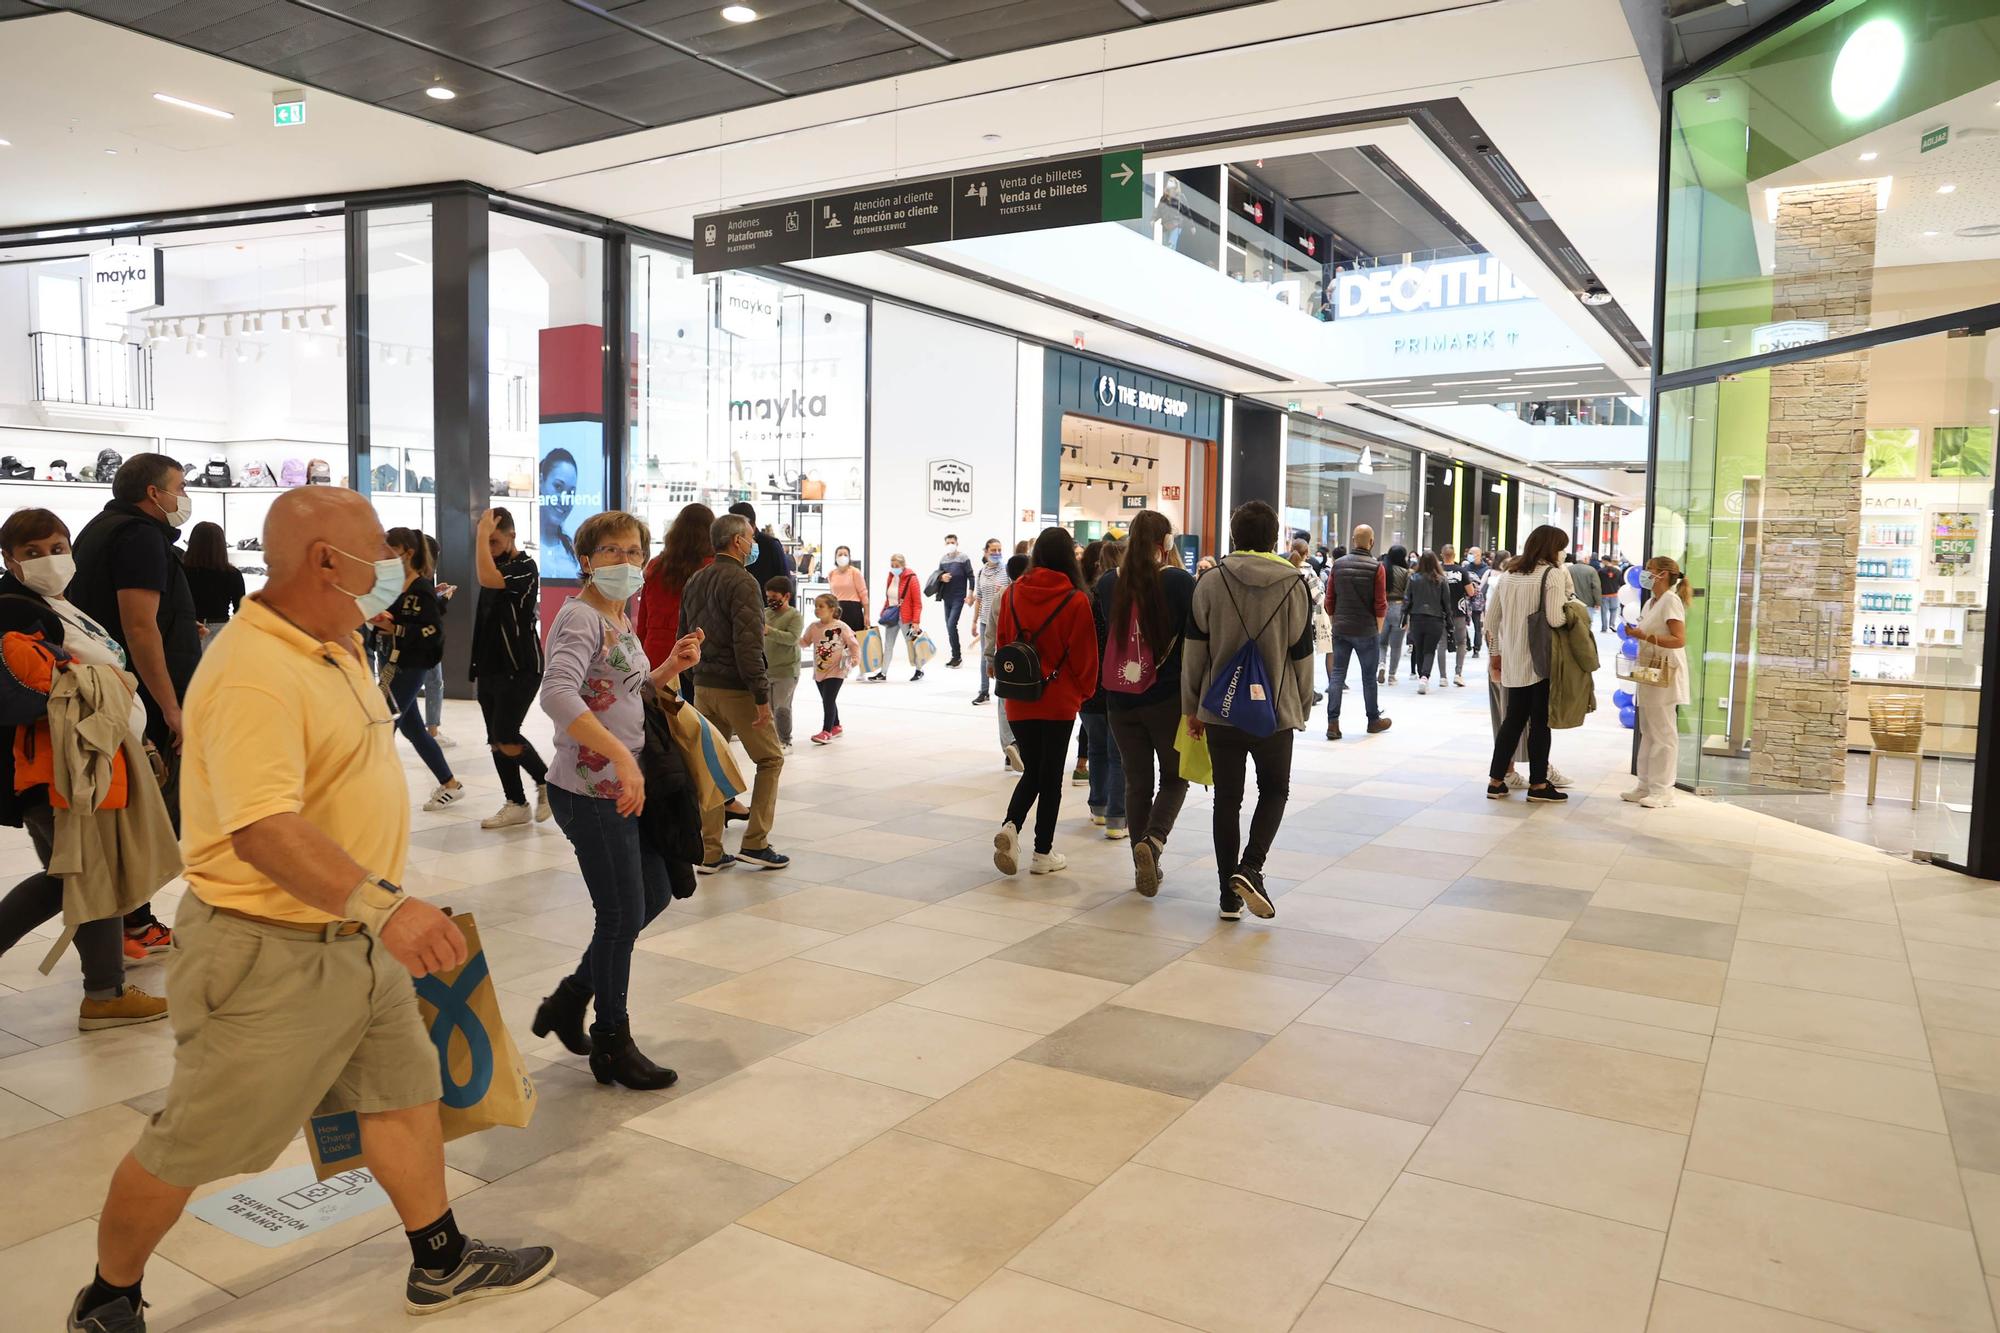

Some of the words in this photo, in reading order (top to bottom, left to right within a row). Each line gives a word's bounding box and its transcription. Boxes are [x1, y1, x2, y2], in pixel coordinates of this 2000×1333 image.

[1000, 177, 1027, 189] Venta
[1030, 174, 1042, 185] de
[1046, 169, 1082, 183] billetes
[854, 197, 890, 212] Atención
[893, 195, 901, 206] al
[904, 191, 934, 204] cliente
[1000, 189, 1030, 204] Venda
[1034, 188, 1046, 199] de
[1050, 183, 1088, 197] billetes
[853, 210, 891, 225] Atención
[894, 210, 905, 219] ao
[908, 204, 939, 218] cliente
[1000, 204, 1025, 215] TICKETS
[1026, 203, 1042, 212] SALE
[728, 218, 760, 230] Andenes
[853, 225, 882, 236] CUSTOMER
[883, 222, 907, 232] SERVICE
[727, 229, 773, 243] Plataformas
[727, 243, 756, 253] PLATFORMS
[96, 265, 146, 285] mayka
[1339, 257, 1538, 317] DECATHL
[729, 296, 772, 315] mayka
[1394, 330, 1496, 353] PRIMARK
[729, 389, 827, 427] mayka
[1117, 385, 1138, 407] THE
[1138, 390, 1163, 413] BODY
[1163, 397, 1188, 418] SHOP
[745, 430, 807, 440] fotwer
[933, 477, 970, 496] mayka
[1127, 497, 1142, 507] FACE
[1865, 497, 1920, 509] FACIAL
[1935, 541, 1973, 553] -50%
[318, 1125, 340, 1135] How
[320, 1131, 356, 1145] Change
[322, 1142, 353, 1154] Looks
[226, 1204, 246, 1214] DE
[241, 1211, 283, 1232] MANOS
[232, 1193, 309, 1231] DESINFECCIÓN
